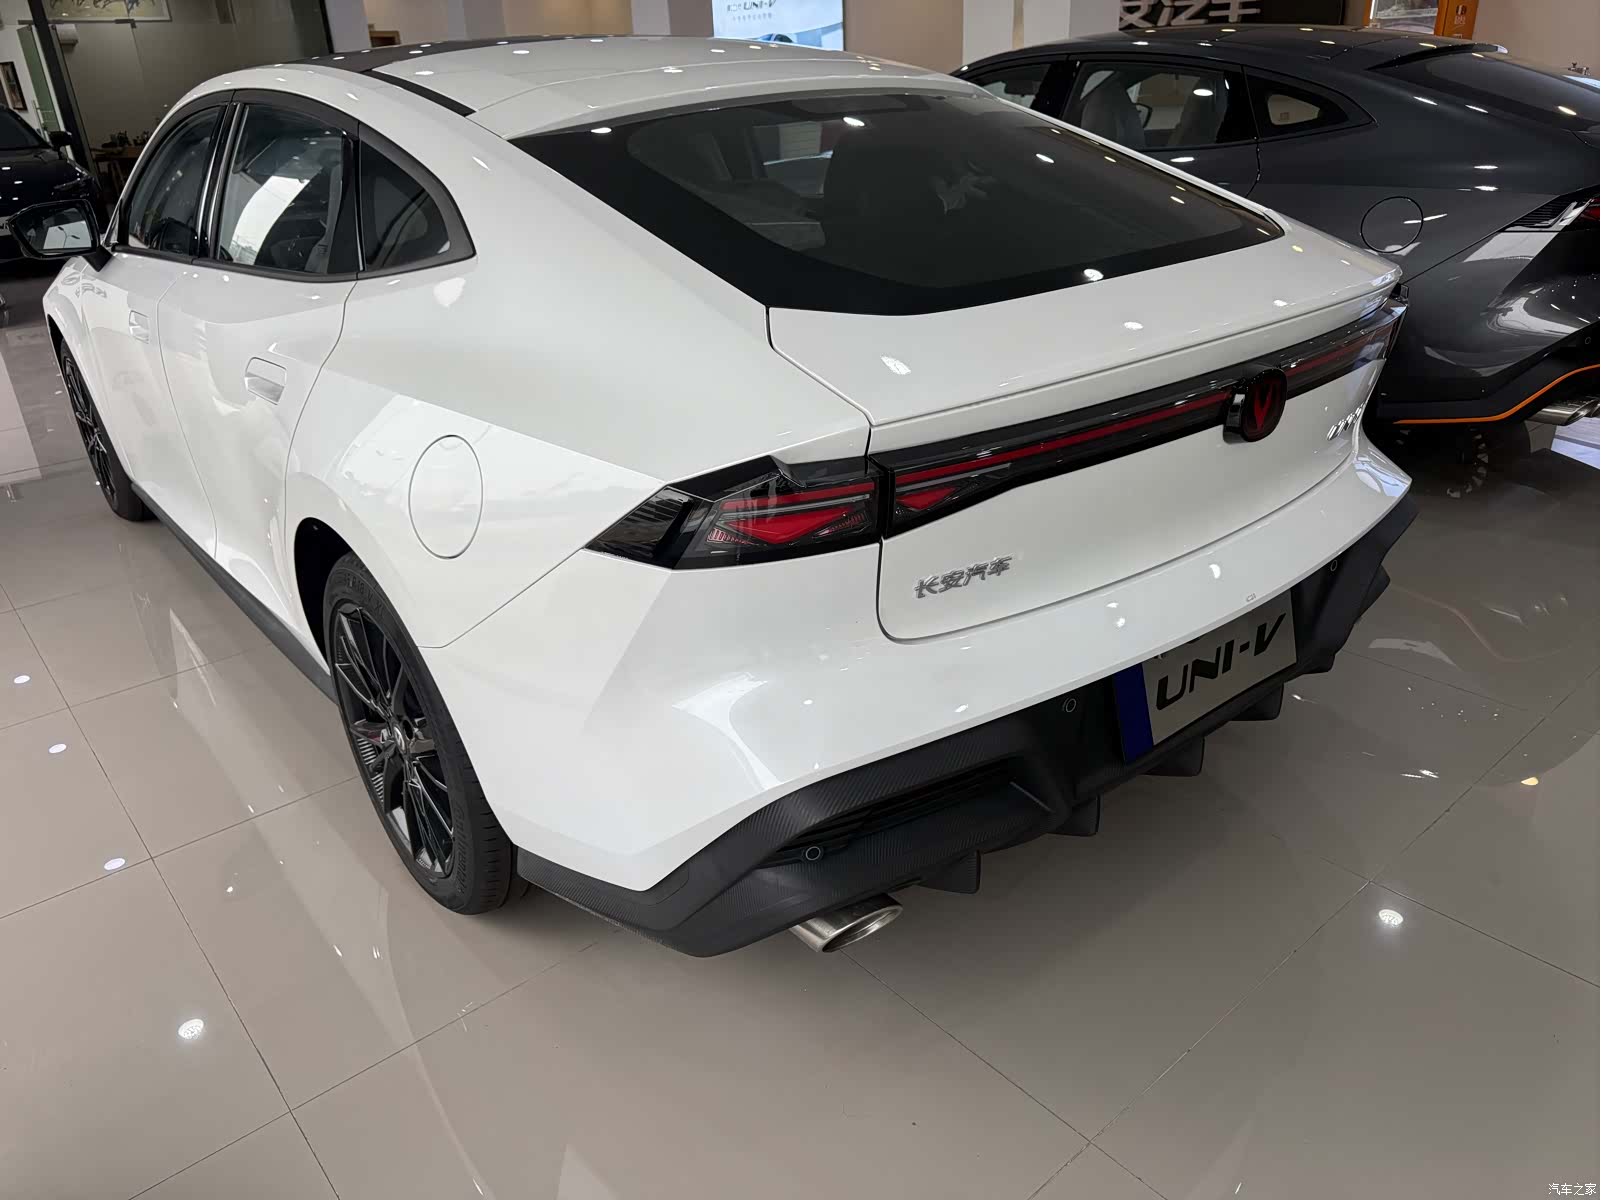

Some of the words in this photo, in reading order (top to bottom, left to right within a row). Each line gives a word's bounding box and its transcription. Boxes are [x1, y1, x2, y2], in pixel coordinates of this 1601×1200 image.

[914, 555, 1013, 599] 长安汽车
[1156, 612, 1287, 711] UNI-V
